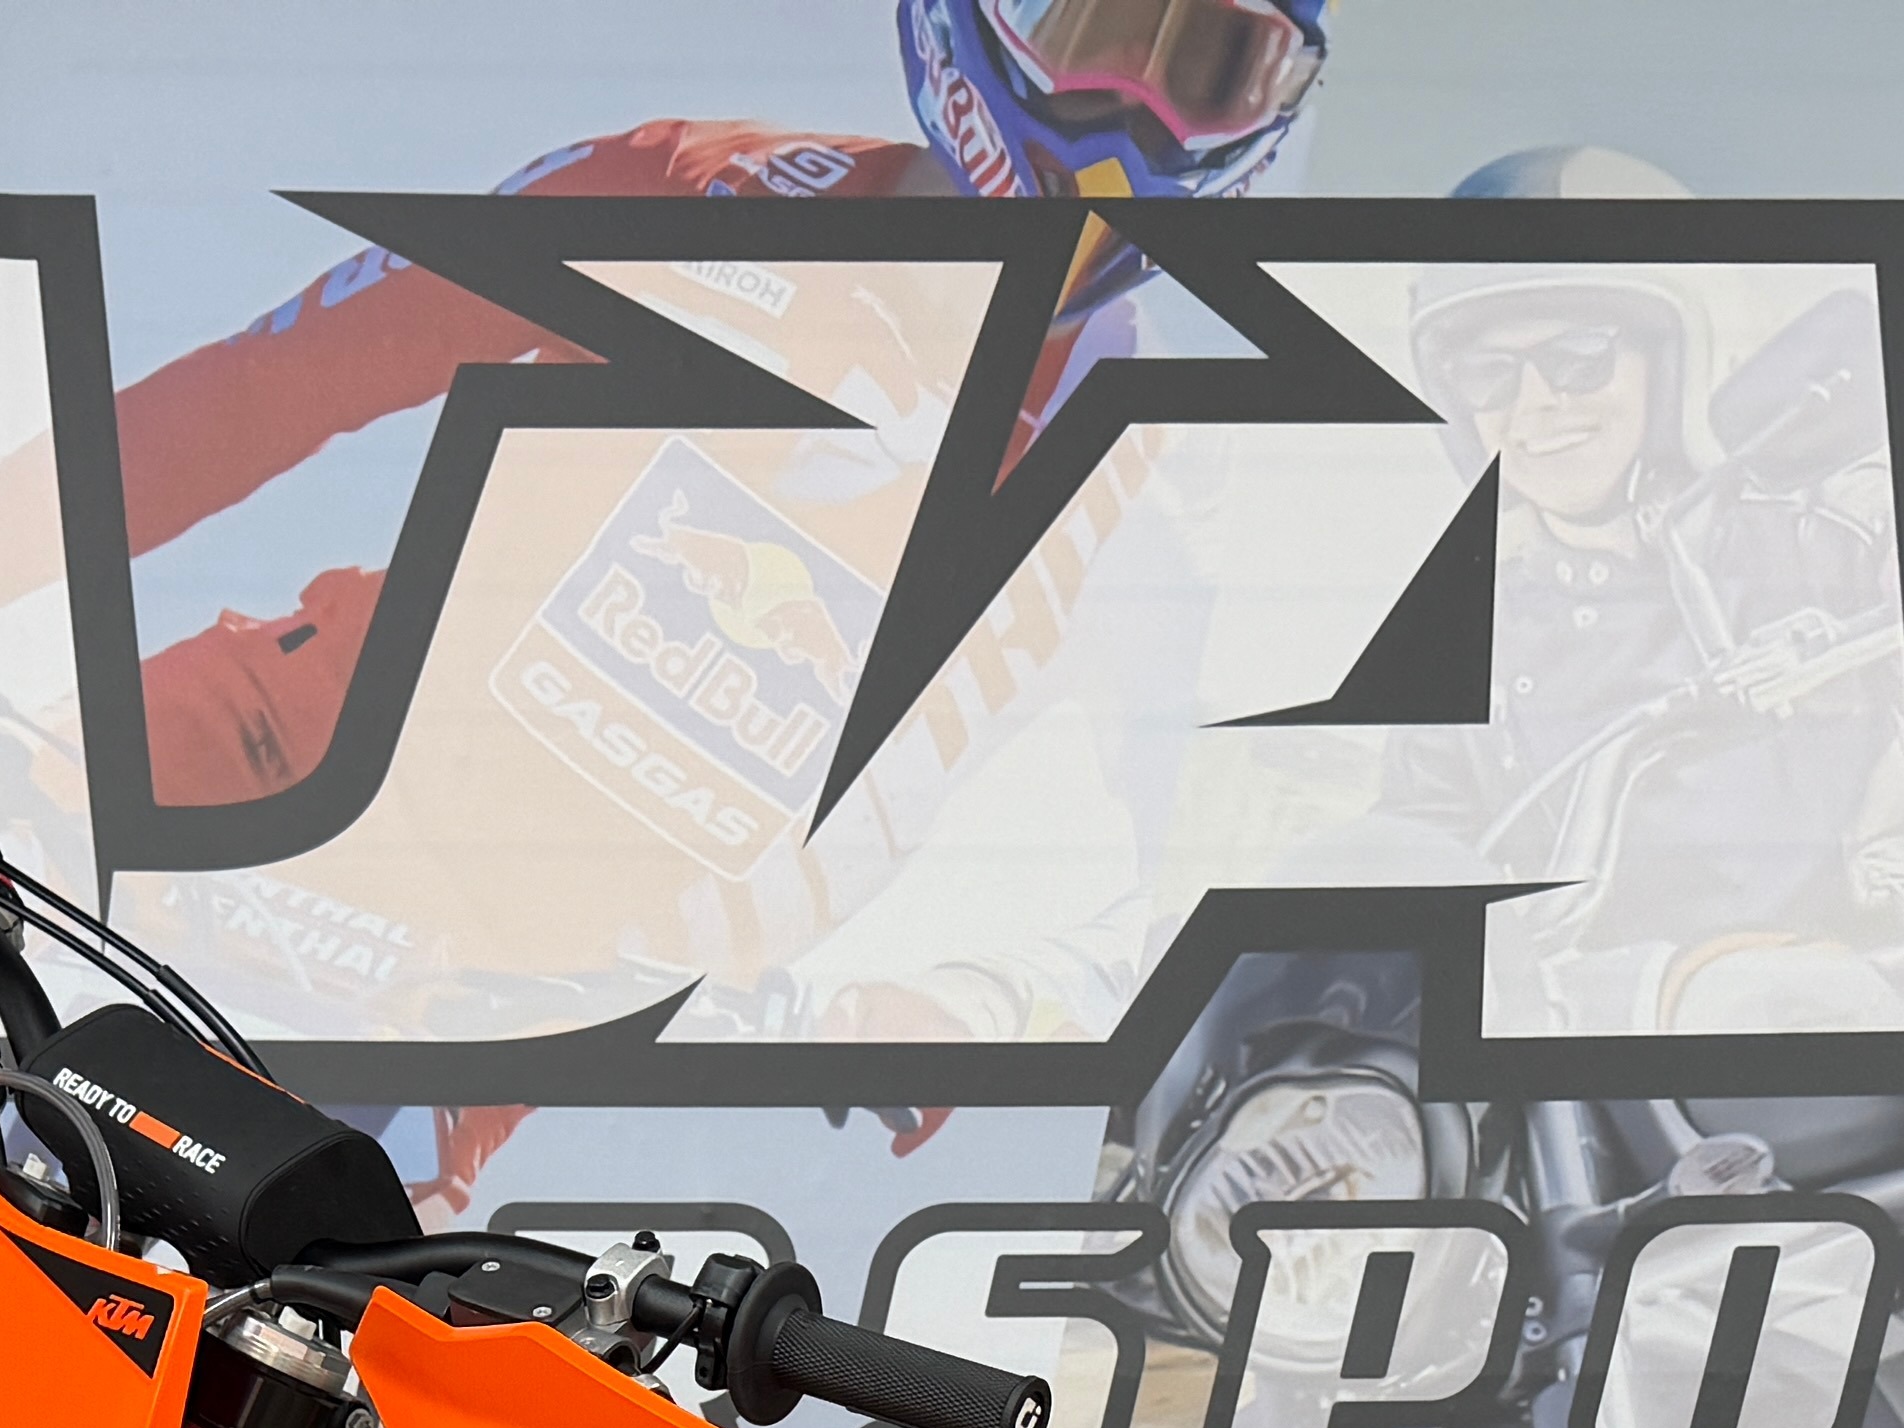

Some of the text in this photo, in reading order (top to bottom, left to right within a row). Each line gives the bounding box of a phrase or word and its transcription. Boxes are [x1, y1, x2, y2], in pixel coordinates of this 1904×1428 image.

[520, 660, 760, 848] GASGAS
[52, 1066, 227, 1174] READY TO RACE
[86, 1293, 156, 1341] KTM
